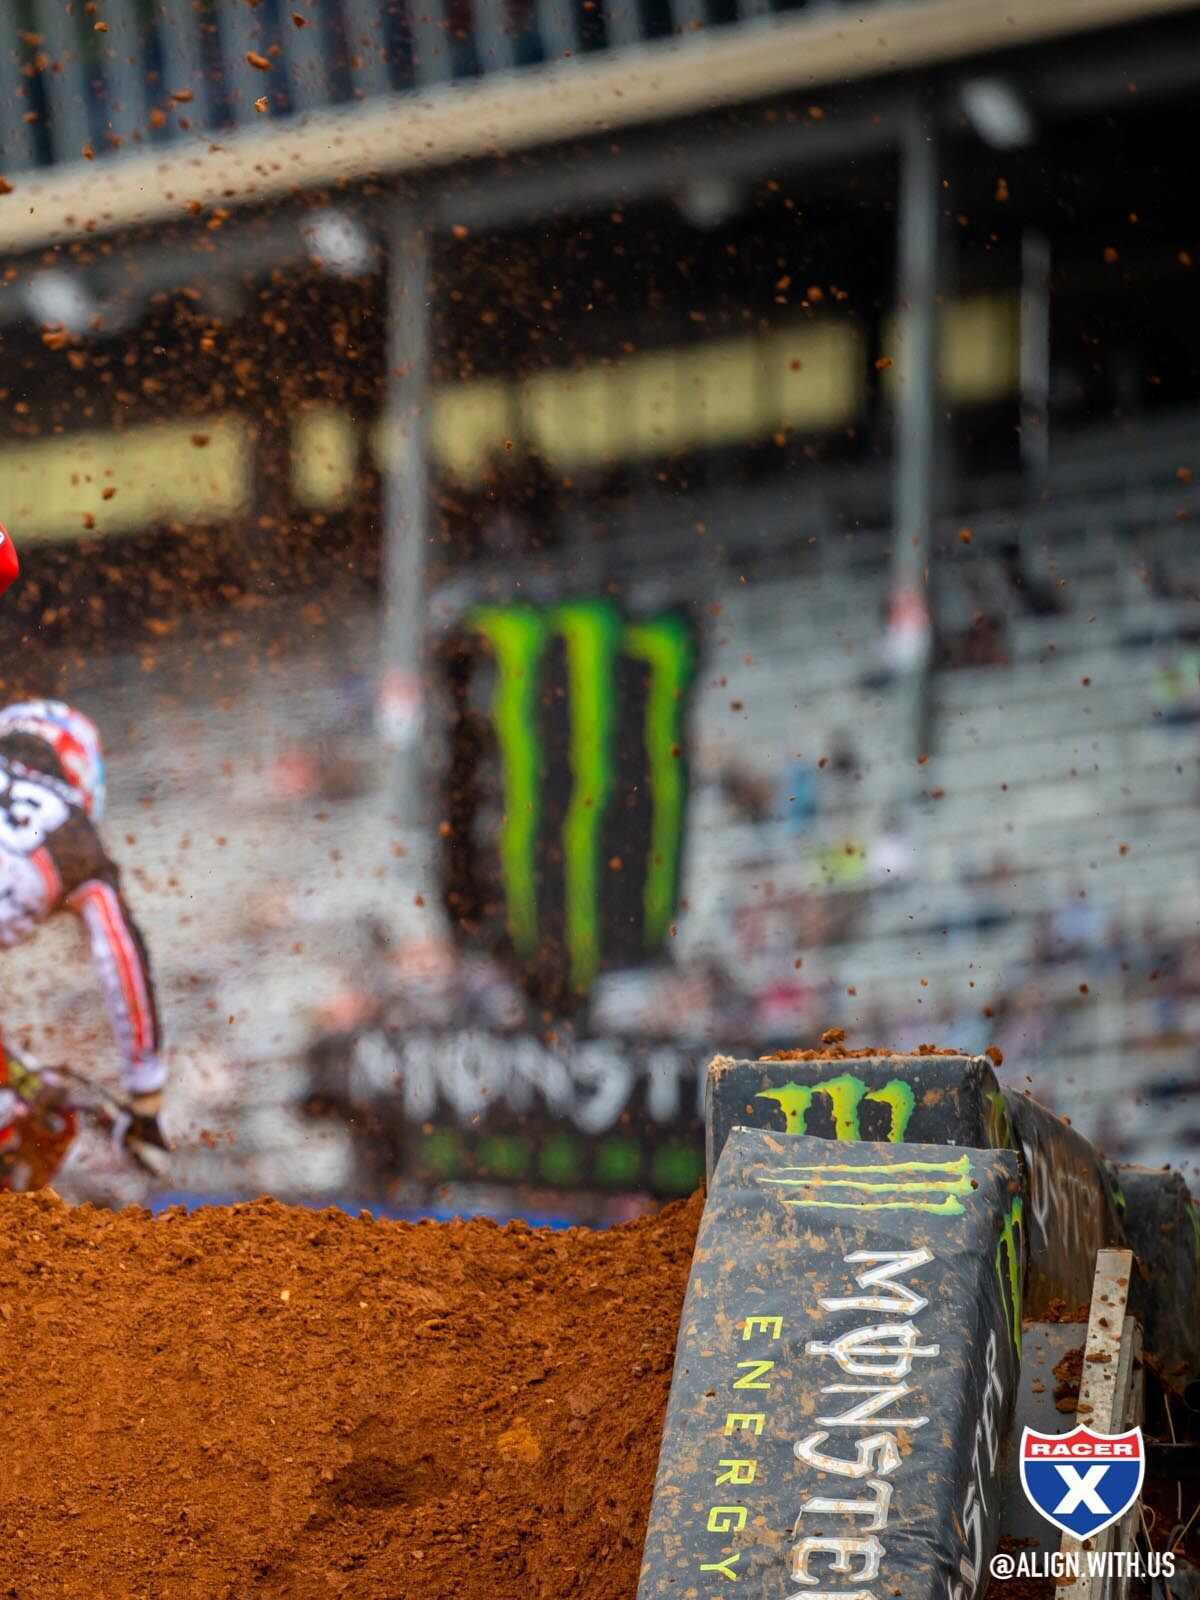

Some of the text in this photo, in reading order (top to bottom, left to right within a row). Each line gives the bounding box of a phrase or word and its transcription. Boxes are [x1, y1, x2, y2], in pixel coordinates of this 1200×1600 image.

[349, 1028, 705, 1134] MONST
[700, 1315, 783, 1581] ENERGY
[784, 1246, 940, 1600] MONSTE
